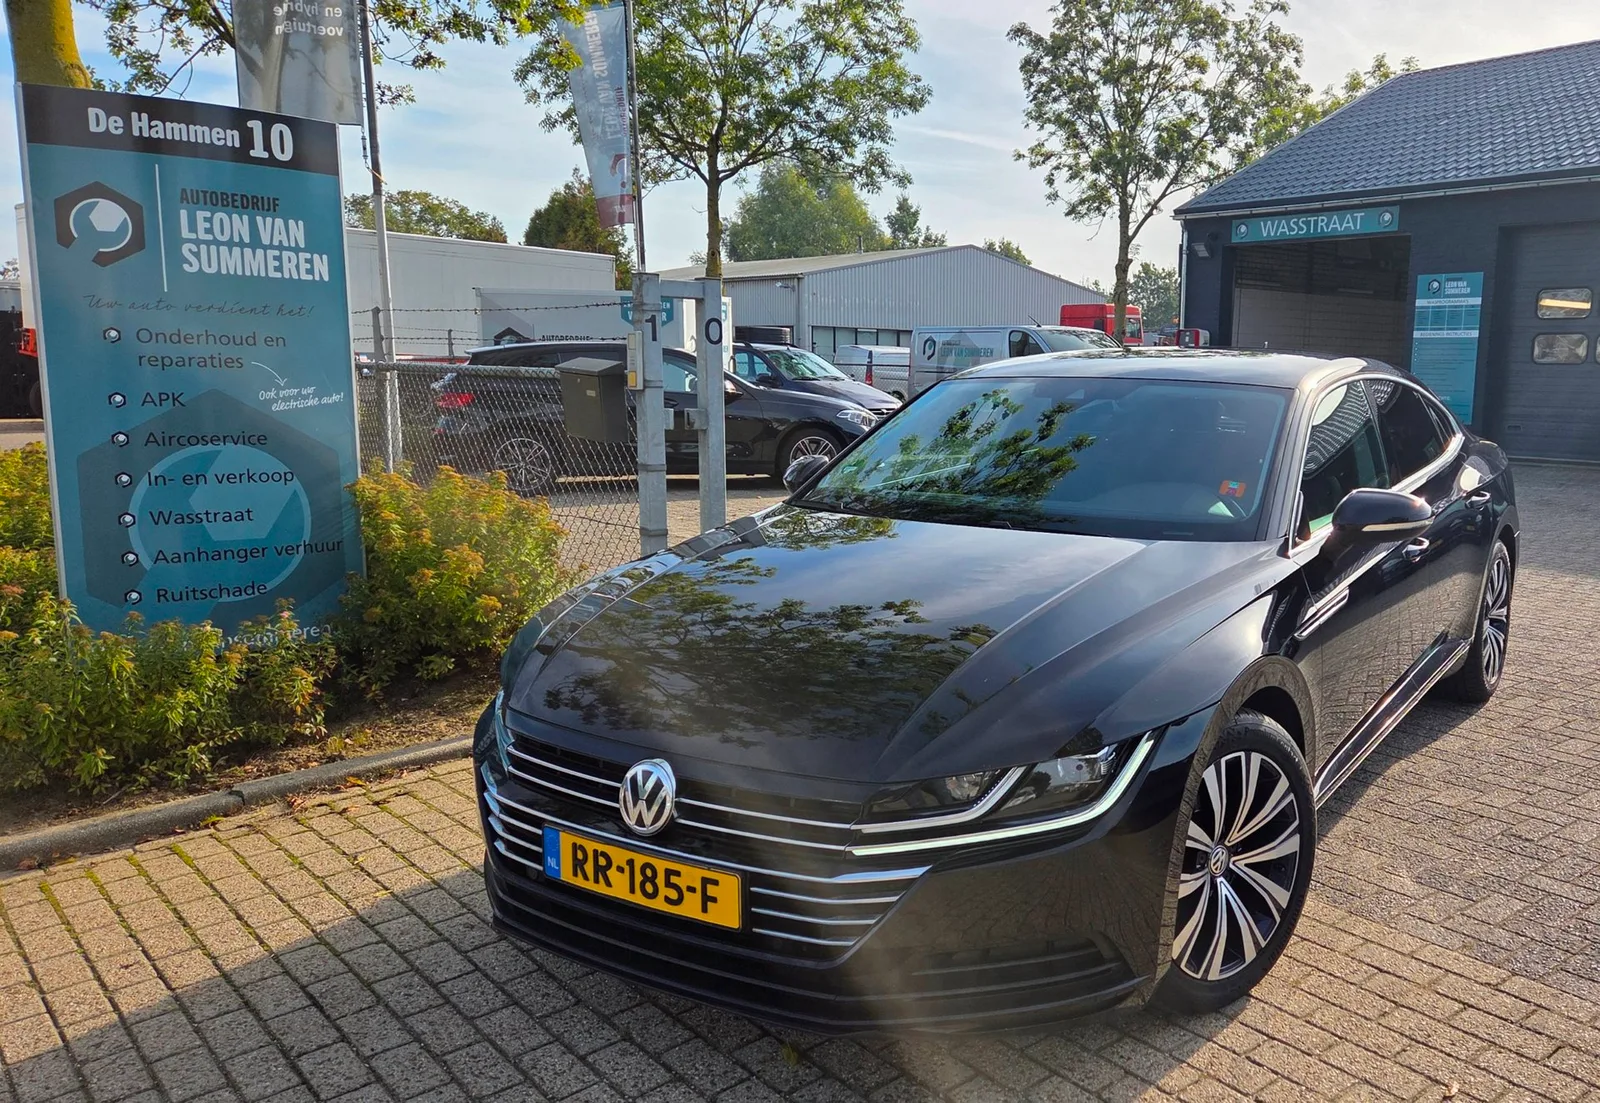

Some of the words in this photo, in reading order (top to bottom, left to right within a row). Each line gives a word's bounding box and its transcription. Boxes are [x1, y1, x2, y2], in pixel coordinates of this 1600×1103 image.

[87, 107, 124, 135] De
[131, 112, 240, 148] Hammen
[247, 119, 294, 162] 10
[180, 187, 280, 213] AUTOBEDRIJF
[180, 209, 250, 243] LEON
[256, 215, 305, 248] VAN
[1260, 212, 1365, 237] WASSTRAAT
[181, 243, 329, 282] SUMMEREN
[83, 294, 123, 310] Uw
[128, 297, 177, 311] auto
[184, 300, 270, 316] verdient
[276, 303, 315, 318] het!
[136, 328, 257, 347] Onderhoud
[264, 335, 286, 348] en
[645, 315, 657, 342] 1
[705, 317, 722, 345] 0
[138, 352, 244, 371] reparaties
[141, 391, 186, 407] APK
[259, 388, 277, 401] Ook
[279, 388, 300, 397] voor
[301, 386, 317, 395] uw
[271, 395, 320, 412] electrische
[320, 392, 344, 405] auto!
[144, 431, 268, 447] Aircoservice
[147, 471, 175, 487] In-
[182, 472, 208, 486] en
[214, 468, 295, 486] verkoop
[149, 507, 254, 526] Wasstraat
[153, 546, 268, 564] Aanhanger
[273, 538, 344, 556] verhuur
[156, 580, 268, 603] Ruitschade
[547, 856, 559, 870] NL
[571, 842, 720, 914] RR-185-F
